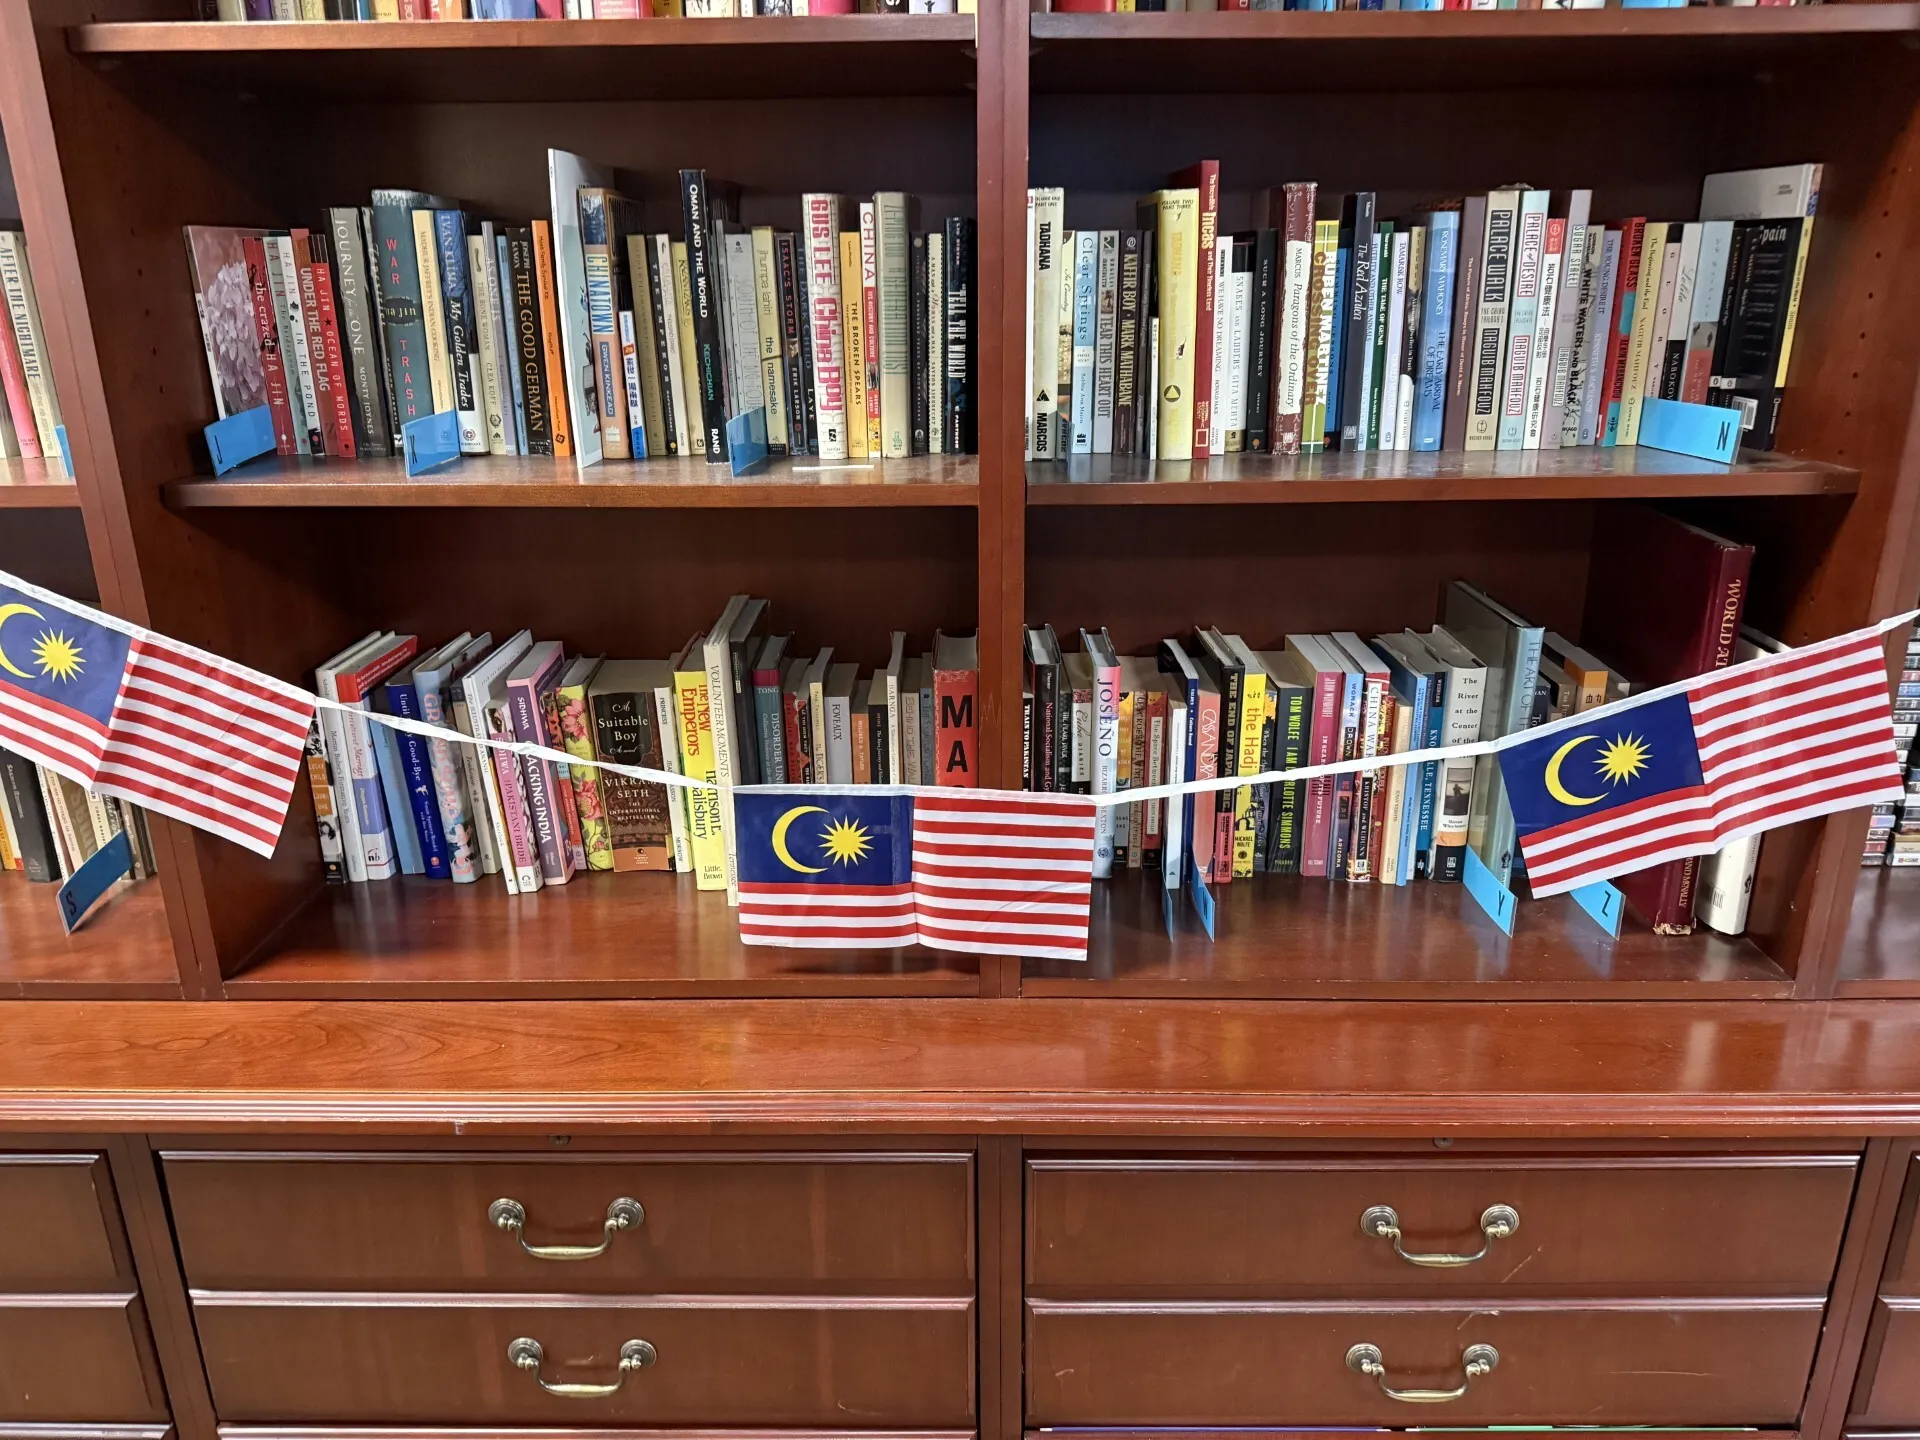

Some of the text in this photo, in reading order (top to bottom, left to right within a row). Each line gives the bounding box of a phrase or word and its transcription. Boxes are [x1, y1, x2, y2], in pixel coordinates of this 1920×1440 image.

[440, 214, 454, 248] IVAN
[689, 184, 707, 318] OMAN AND THE WORLD
[811, 199, 833, 285] GUS LEE
[864, 211, 875, 281] CHINA
[1038, 222, 1052, 271] TADHANA
[1201, 212, 1217, 249] Incas
[1484, 211, 1510, 302] PALACE WALK
[1524, 216, 1541, 252] PALACE
[1567, 226, 1583, 288] SUGAR STREET
[1626, 222, 1645, 288] BROKEN GLASS
[335, 220, 356, 297] JOURNEY
[350, 320, 364, 355] ONE
[386, 238, 400, 284] WAR
[758, 250, 773, 315] jhumpa lahiri
[780, 243, 795, 334] ISAAC'S STORM
[1079, 237, 1094, 340] Clear Springs
[1122, 253, 1138, 312] KAFFIR BOY
[1294, 247, 1302, 279] MARCUS
[1353, 243, 1370, 321] The Red Azalea
[1519, 261, 1537, 295] DESIRE
[1678, 267, 1694, 303] Lolita
[0, 247, 41, 380] AFTER THE NIGHTMARE
[586, 255, 614, 333] CHINATOWN
[1261, 290, 1267, 298] A
[256, 282, 284, 405] the crazed HA JIN
[283, 253, 316, 417] HA JIN IN THE POND
[300, 268, 330, 391] UNDER THE RED FLAG
[317, 269, 348, 431] HA JIN OCEAN OF WORDS
[449, 300, 469, 408] My Golden Trades
[517, 271, 543, 431] THE GOOD GERMAN
[814, 297, 843, 411] China Boy
[852, 326, 860, 366] BROKEN
[948, 320, 966, 340] THE
[1286, 283, 1303, 408] Paragons of the Ordinary
[1305, 251, 1327, 406] CROSSING OVER
[1316, 251, 1337, 406] RUBEN MARTINEZ
[1566, 269, 1593, 404] WHITE WATERS AND BLACK
[400, 340, 416, 415] TRASH
[600, 343, 614, 415] GWEN KINKEAD
[703, 344, 714, 401] KECHICHIAN
[765, 337, 778, 415] the namesake
[854, 370, 862, 405] SPEARS
[1097, 316, 1114, 418] TEAR THIS HEART OUT
[1118, 319, 1135, 407] MARK MATHABANE
[1424, 346, 1435, 398] OF DREAMS
[1432, 331, 1447, 412] THE EARLY ARRIVAL
[1476, 329, 1498, 413] NAGUIB MAHFOUZ
[1508, 338, 1527, 413] NAGUIB MAHFOUZ
[1666, 353, 1681, 400] NABOKOV
[358, 367, 375, 435] MONTY JOYNES
[710, 428, 720, 454] RAND
[1037, 412, 1047, 452] MARCOS
[1716, 421, 1730, 451] N
[1719, 579, 1742, 645] WORLD
[399, 693, 409, 715] Until
[517, 696, 530, 730] SIDHWA
[598, 717, 649, 728] Suitable
[681, 687, 700, 756] Emperors
[710, 665, 730, 778] VOLUNTEER MOMENTS
[832, 703, 841, 740] FOVEAUX
[1044, 702, 1054, 733] National
[1097, 678, 1115, 757] JOSEÑO
[1287, 695, 1303, 740] TOM WOLFE
[1349, 683, 1357, 718] WOMACK
[408, 741, 422, 782] Good-Bye
[615, 731, 637, 743] Boy
[1022, 742, 1030, 778] PAKISTAN
[1023, 731, 1030, 741] TO
[1044, 734, 1053, 766] Socialism
[1199, 708, 1217, 780] CASSANDRA
[1240, 708, 1260, 769] the Hadj
[1285, 752, 1297, 764] AM
[1282, 766, 1296, 809] CRLOTTE
[1360, 780, 1370, 811] KRISTOF
[1420, 782, 1434, 831] TENNESSEE
[504, 783, 528, 863] PAKISTANI BRIDE
[535, 806, 551, 844] INDIA
[1279, 812, 1294, 849] SIMMONS
[1358, 825, 1367, 856] WUDUNN
[66, 890, 77, 916] S
[1498, 890, 1505, 916] Y
[1601, 889, 1612, 917] Z
